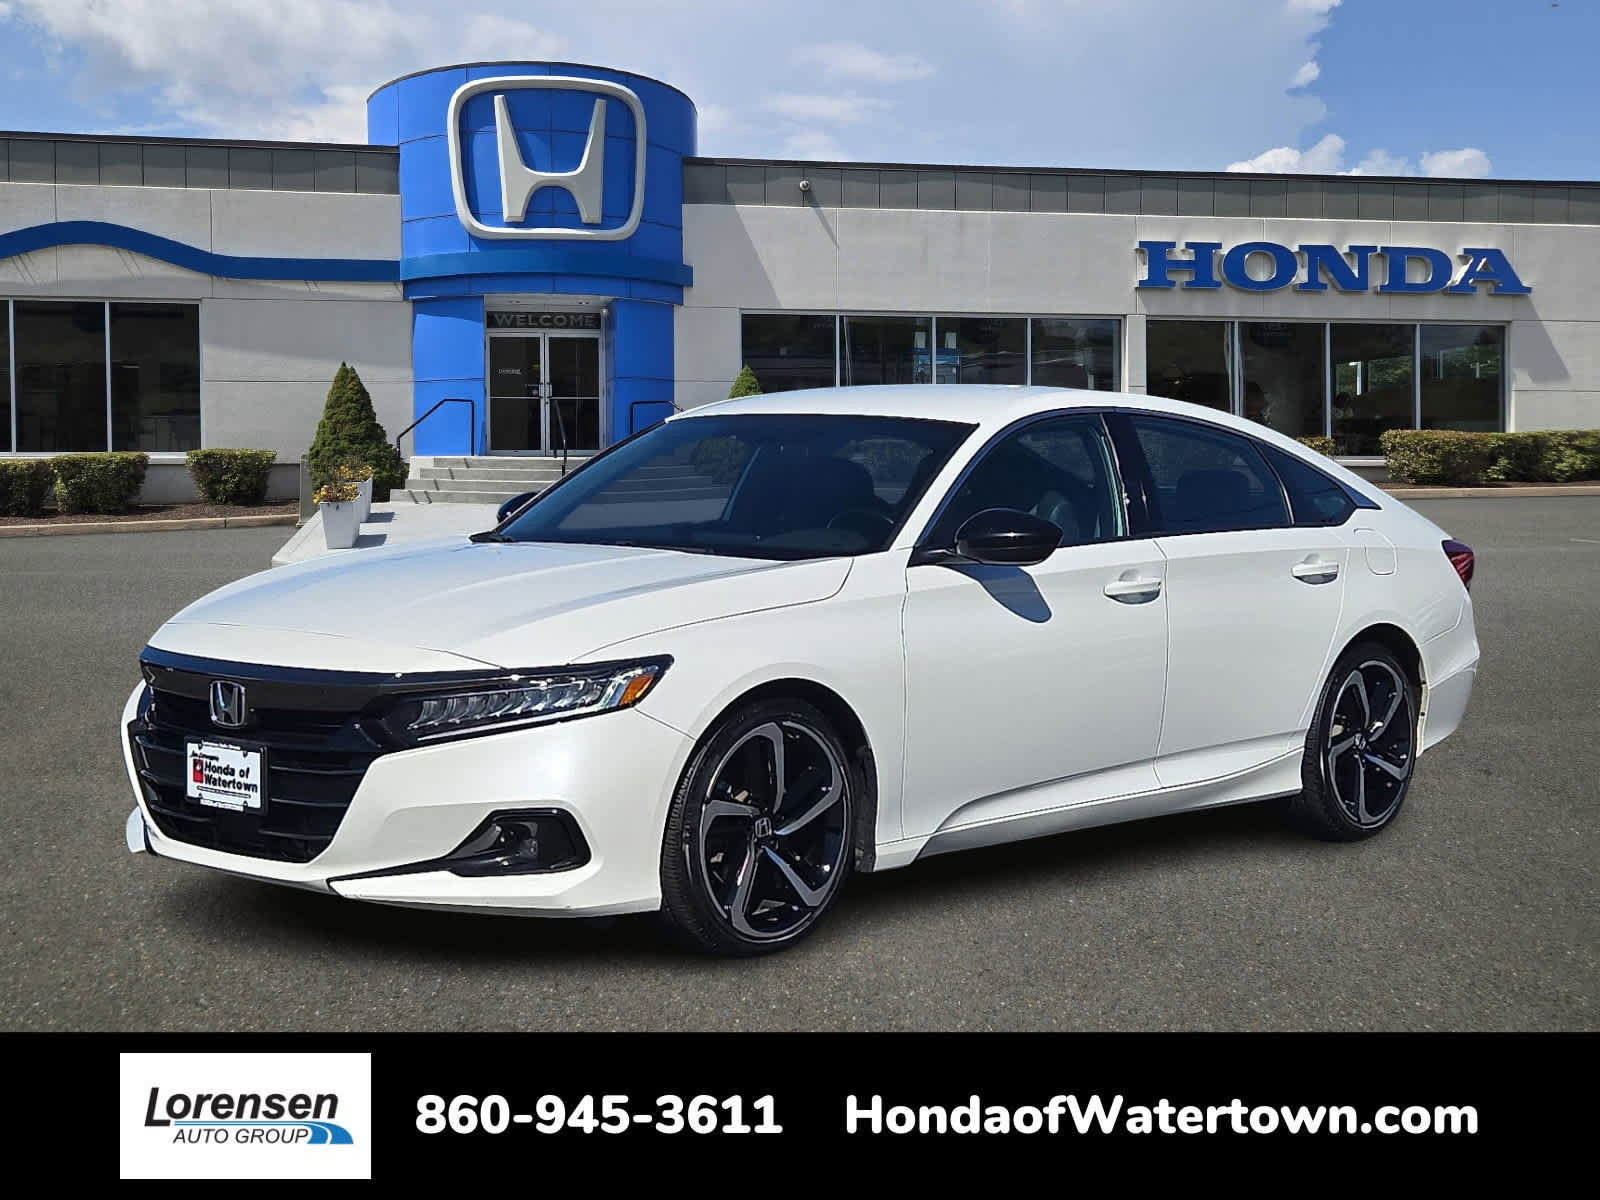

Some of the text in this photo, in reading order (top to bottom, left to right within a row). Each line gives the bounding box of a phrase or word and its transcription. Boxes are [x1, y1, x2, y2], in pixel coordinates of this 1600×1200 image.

[1137, 241, 1532, 295] HONDA
[494, 313, 597, 327] WELCOME
[204, 761, 250, 779] Honda of
[204, 774, 258, 794] Watertown
